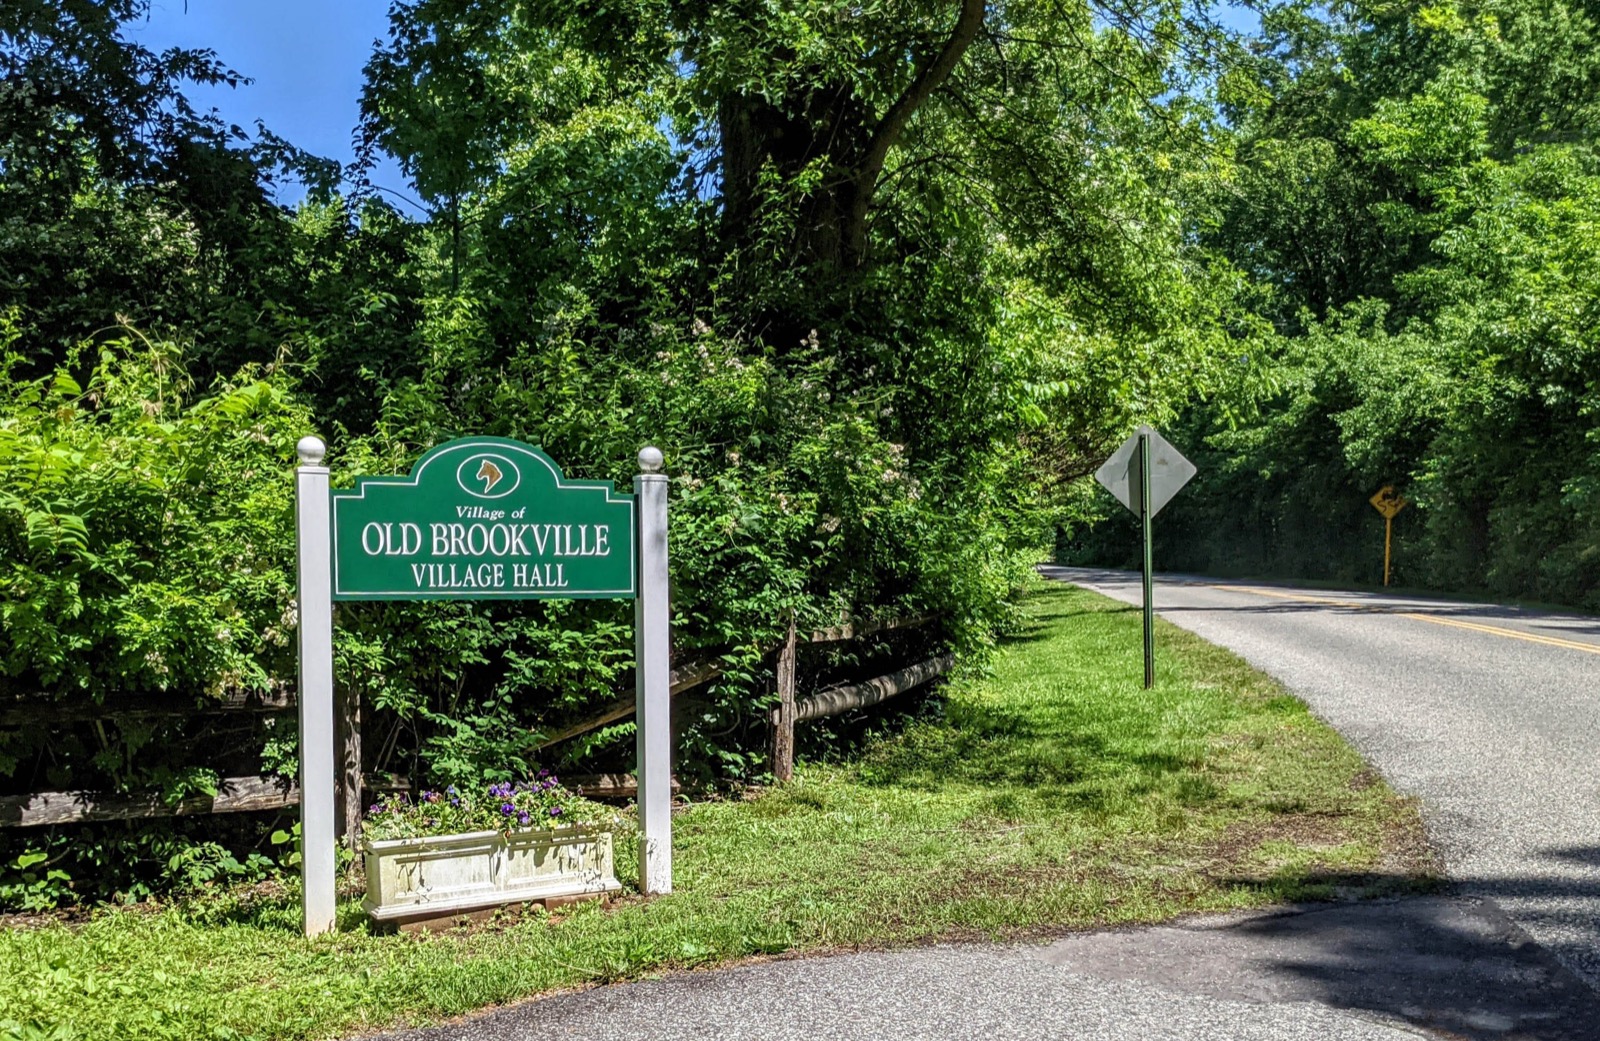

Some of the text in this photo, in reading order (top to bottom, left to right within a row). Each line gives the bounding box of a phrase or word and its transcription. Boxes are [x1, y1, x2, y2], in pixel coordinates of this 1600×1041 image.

[456, 505, 526, 521] Village of
[361, 522, 611, 556] OLD BROOKVILLE
[411, 563, 569, 588] VILLAGE HALL
